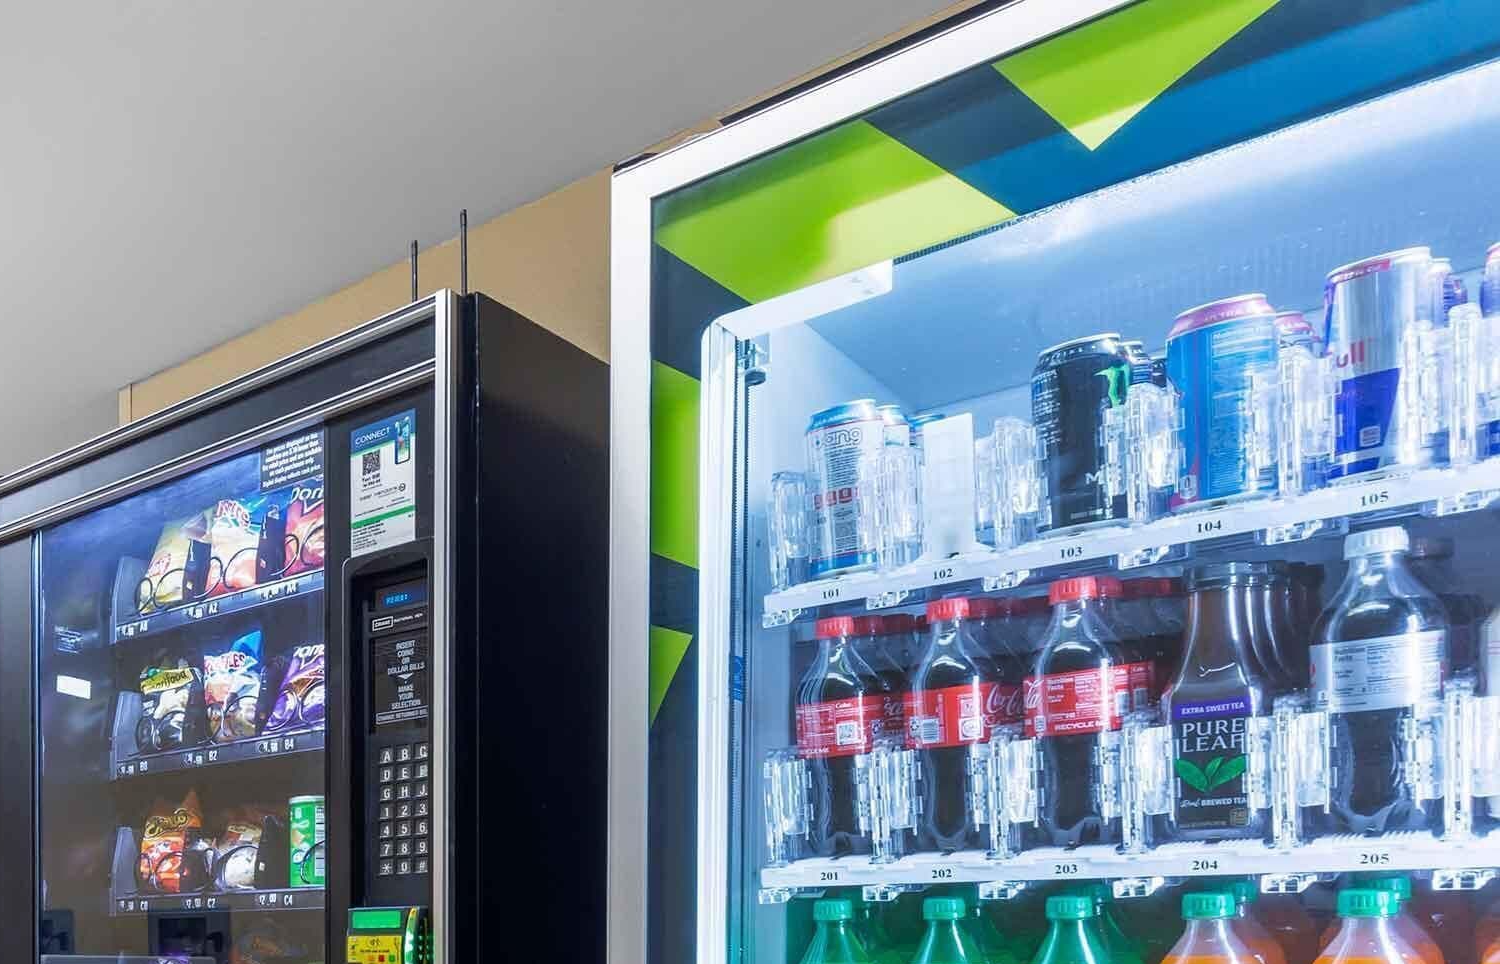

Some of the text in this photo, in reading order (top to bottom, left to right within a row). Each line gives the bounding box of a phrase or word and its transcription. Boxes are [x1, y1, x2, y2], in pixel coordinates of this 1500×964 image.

[355, 426, 391, 445] CONNECT
[1360, 491, 1389, 507] 105
[1196, 520, 1222, 533] 104
[1059, 546, 1083, 559] 103
[932, 568, 954, 580] 102
[822, 588, 841, 600] 101
[396, 640, 416, 650] INSERT
[402, 656, 410, 664] OR
[388, 661, 426, 675] DOLLAR BILLS
[398, 684, 414, 693] MAKE
[398, 692, 414, 701] YOUR
[391, 699, 421, 710] SELECTION
[1181, 701, 1245, 715] EXTRA SWEET TEA
[1182, 717, 1245, 738] PURE
[1182, 732, 1245, 753] LEAF
[384, 746, 426, 762] A B C
[384, 768, 408, 780] D E
[384, 788, 390, 800] G
[401, 786, 408, 798] H
[1201, 797, 1233, 807] BREWED
[384, 803, 426, 817] 1 2 3
[383, 822, 426, 836] 4 5 6
[384, 841, 426, 855] 7 8 9
[1359, 852, 1390, 865] 205
[401, 861, 408, 872] 0
[1054, 863, 1078, 875] 203
[1192, 860, 1218, 871] 204
[820, 871, 839, 882] 201
[931, 868, 953, 879] 202
[284, 894, 293, 906] C4
